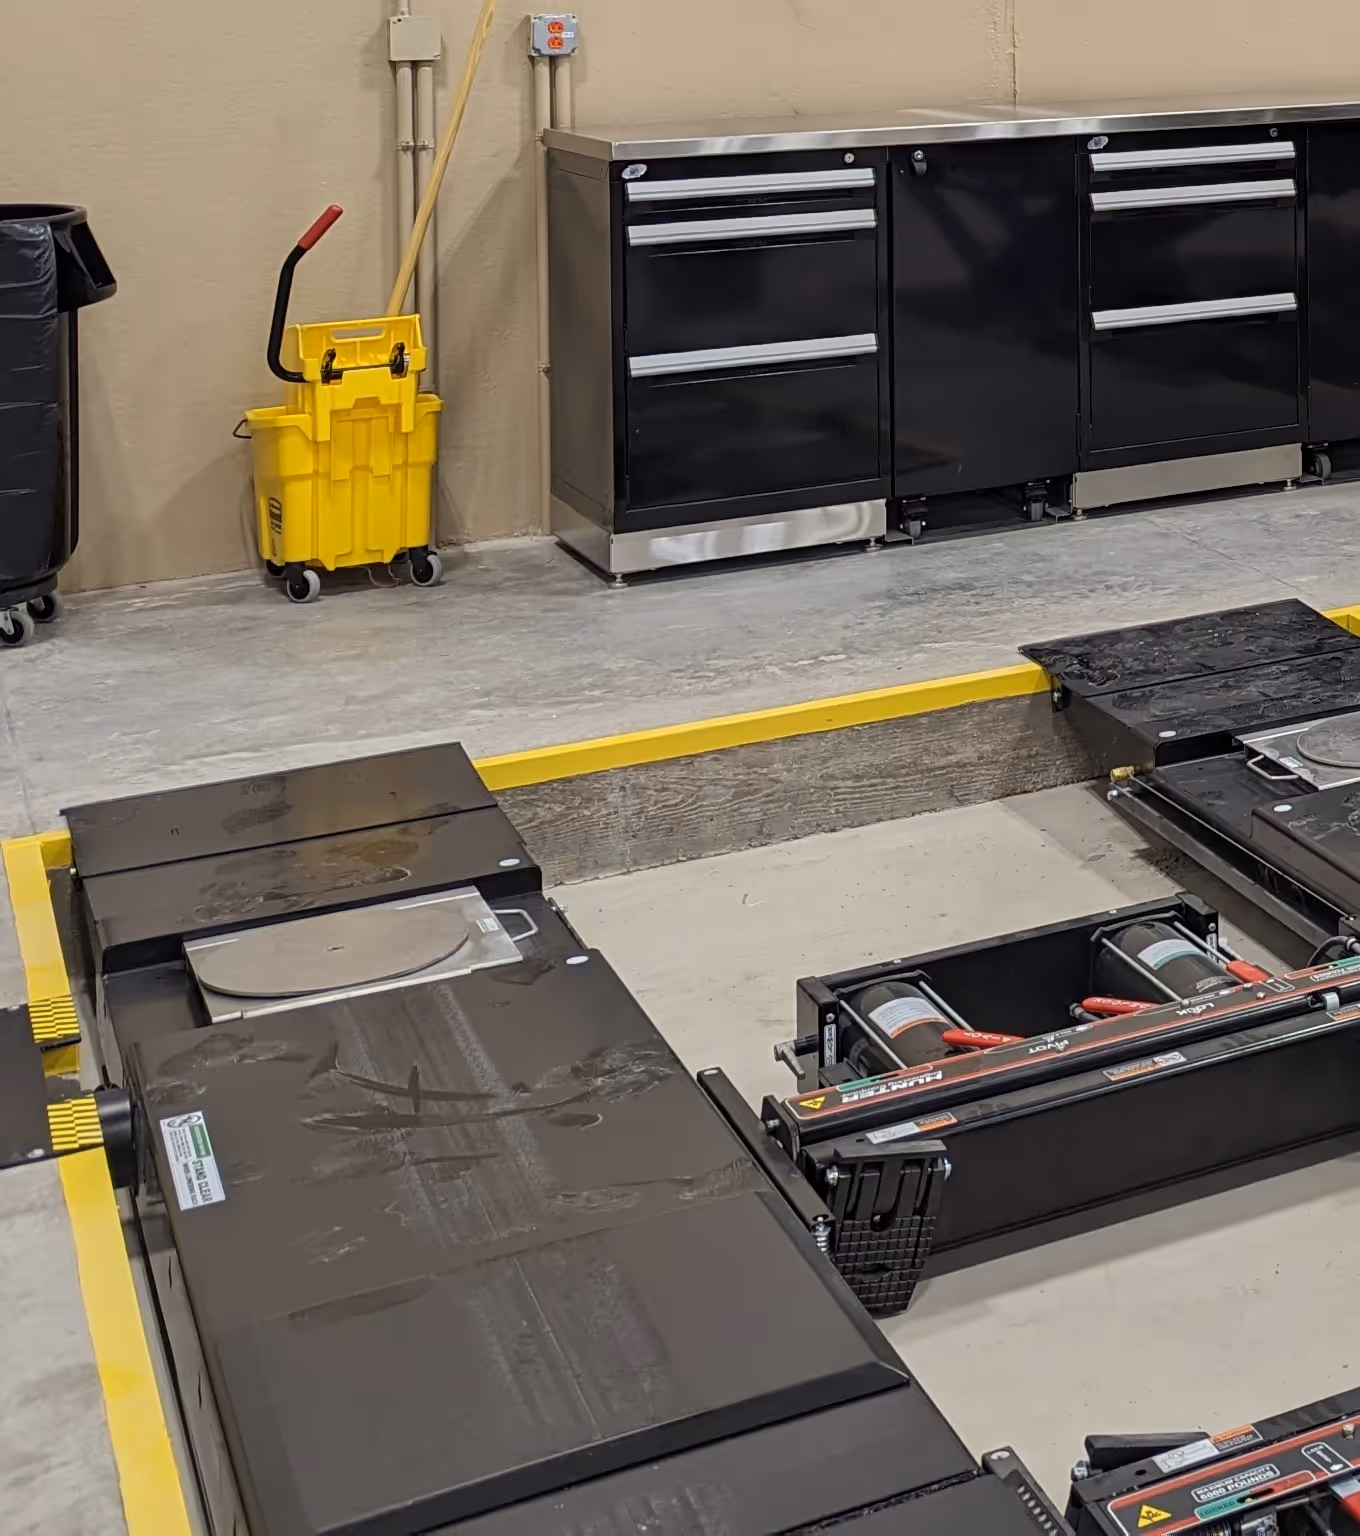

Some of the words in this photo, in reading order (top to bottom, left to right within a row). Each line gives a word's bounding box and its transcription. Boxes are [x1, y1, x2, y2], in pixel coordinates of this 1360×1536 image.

[842, 1070, 943, 1103] HUNTER
[191, 1159, 207, 1181] STAND
[198, 1180, 213, 1203] CLEAR
[1227, 1469, 1274, 1491] POUNDS
